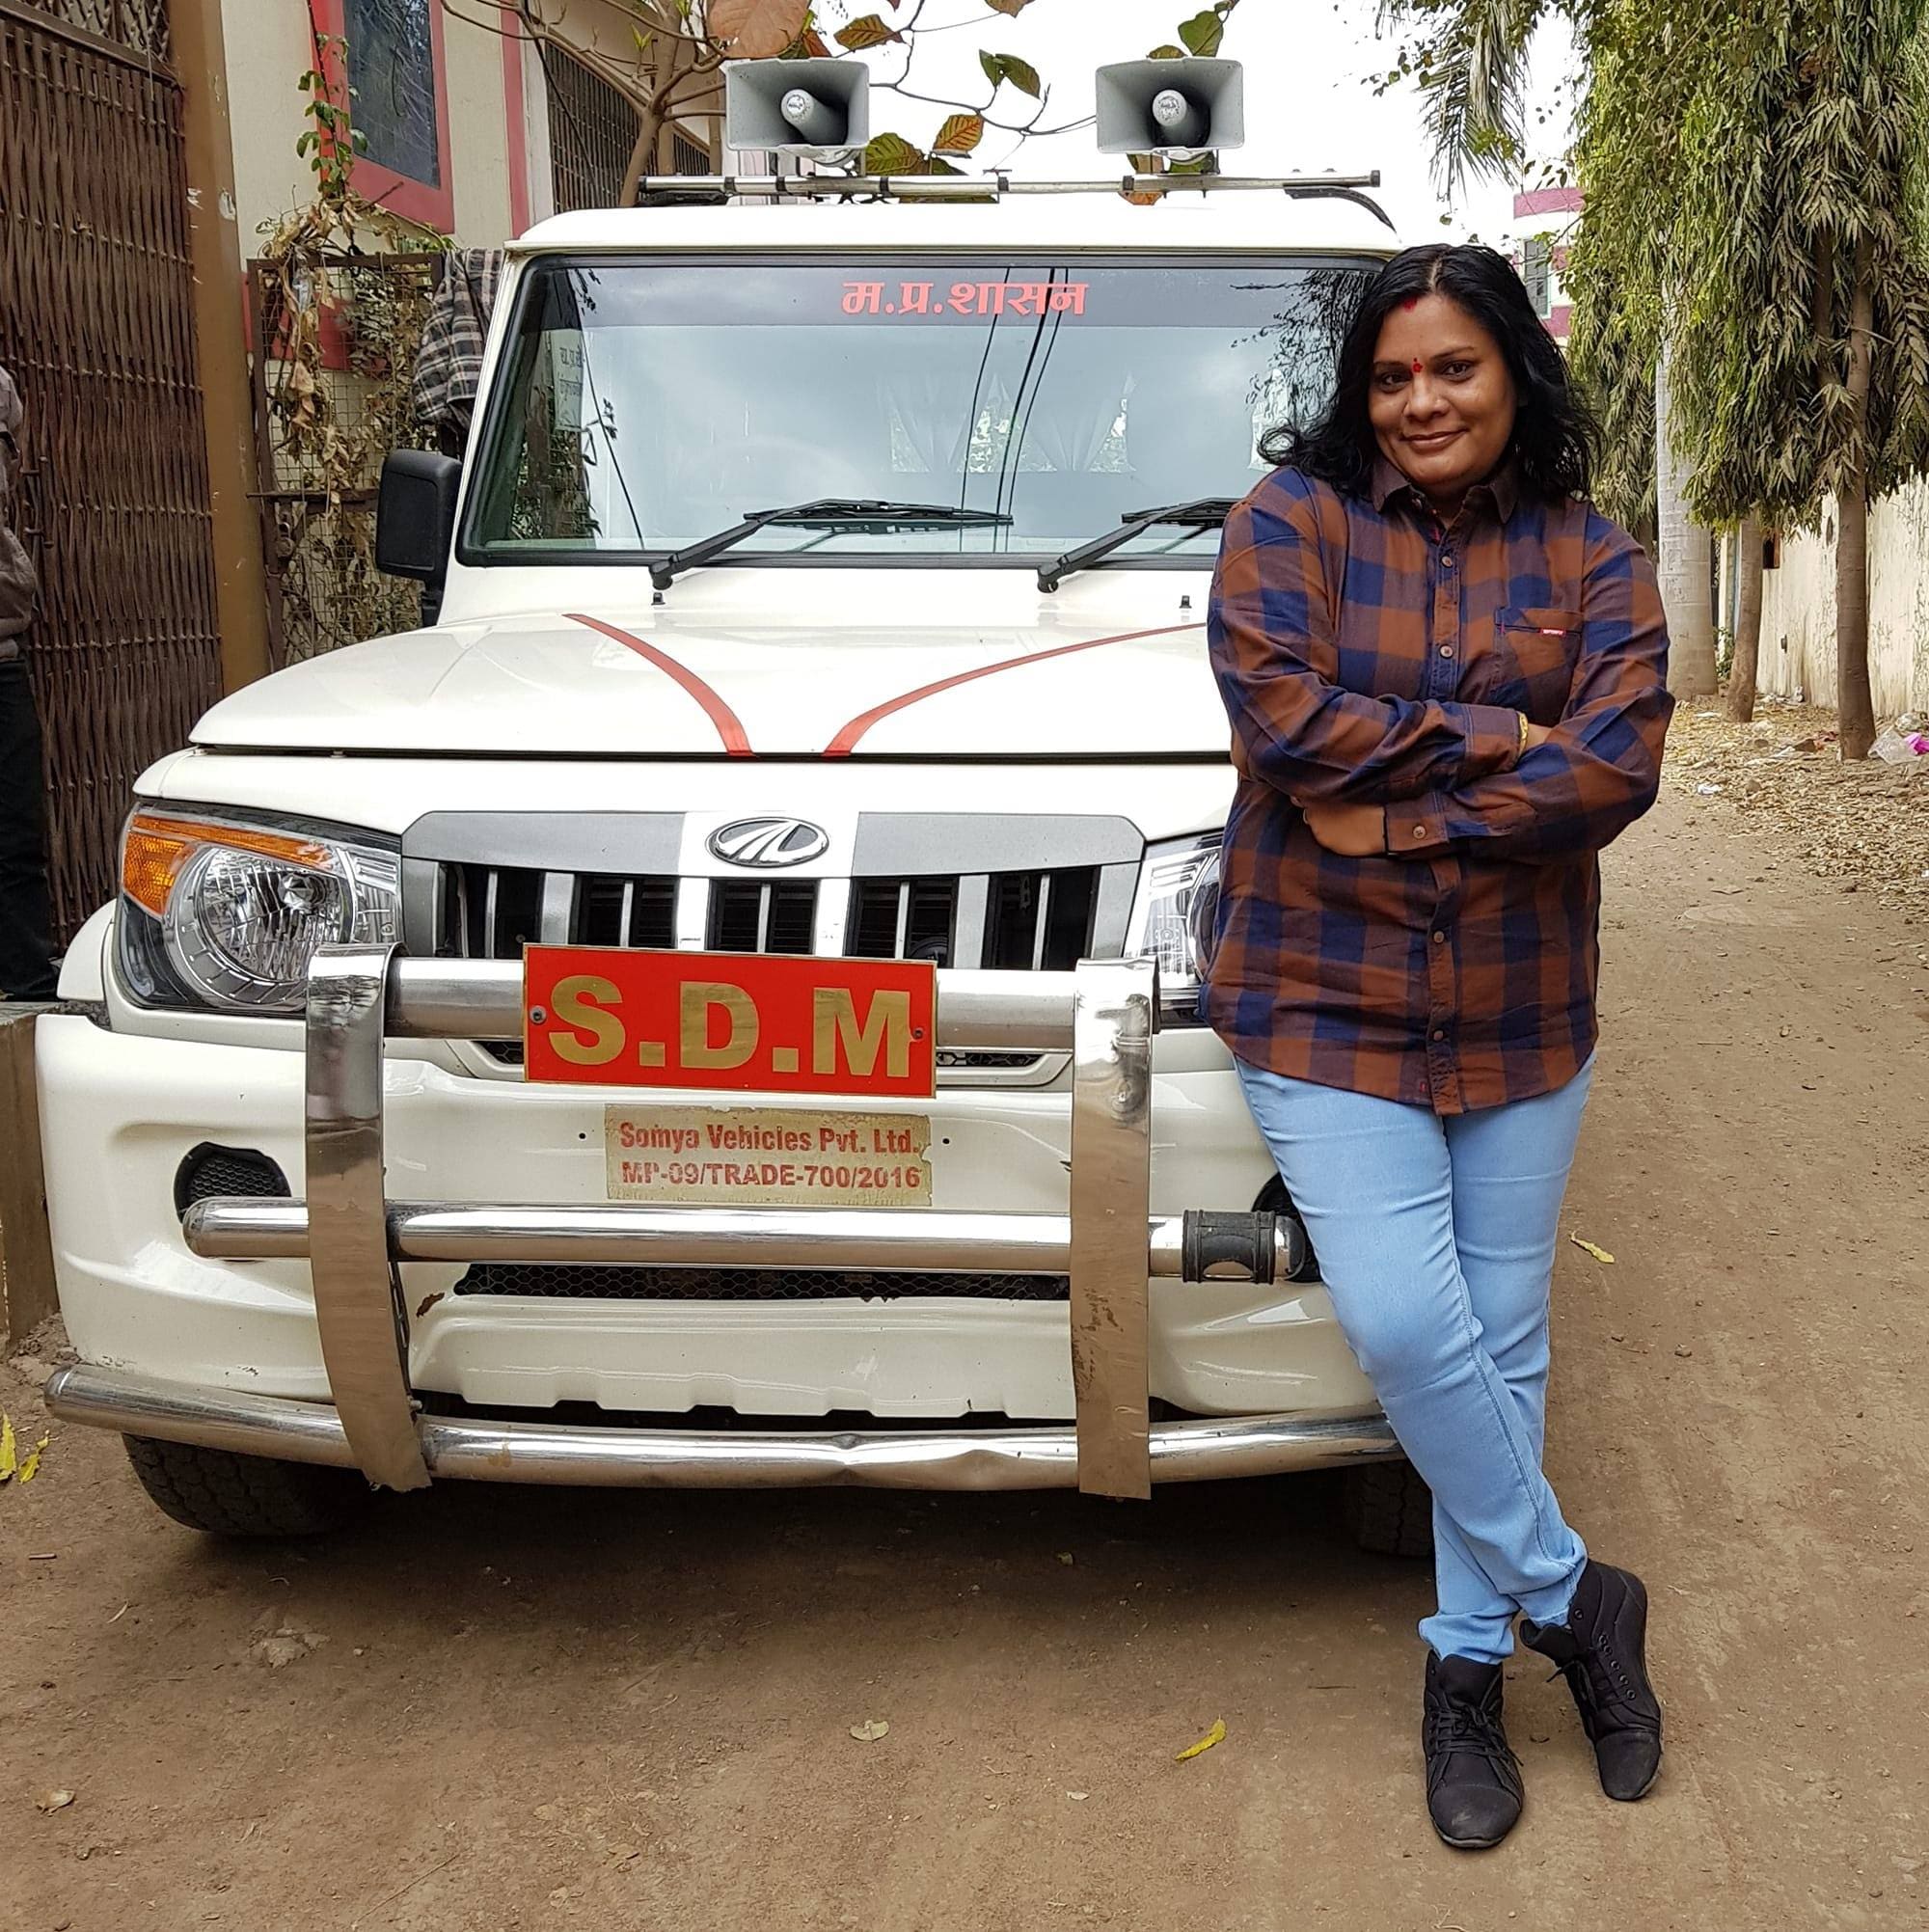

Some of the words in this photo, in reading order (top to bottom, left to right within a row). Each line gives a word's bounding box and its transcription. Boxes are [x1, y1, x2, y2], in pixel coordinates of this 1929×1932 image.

[841, 282, 1089, 315] म.प्र.शासन
[548, 974, 910, 1077] S.D.M
[619, 1122, 700, 1154] Somya
[707, 1124, 812, 1152] Vehicles
[819, 1128, 866, 1154] Pvt.
[874, 1129, 921, 1154] Ltd.
[621, 1161, 921, 1189] MP-09/TRADE-700/2016
